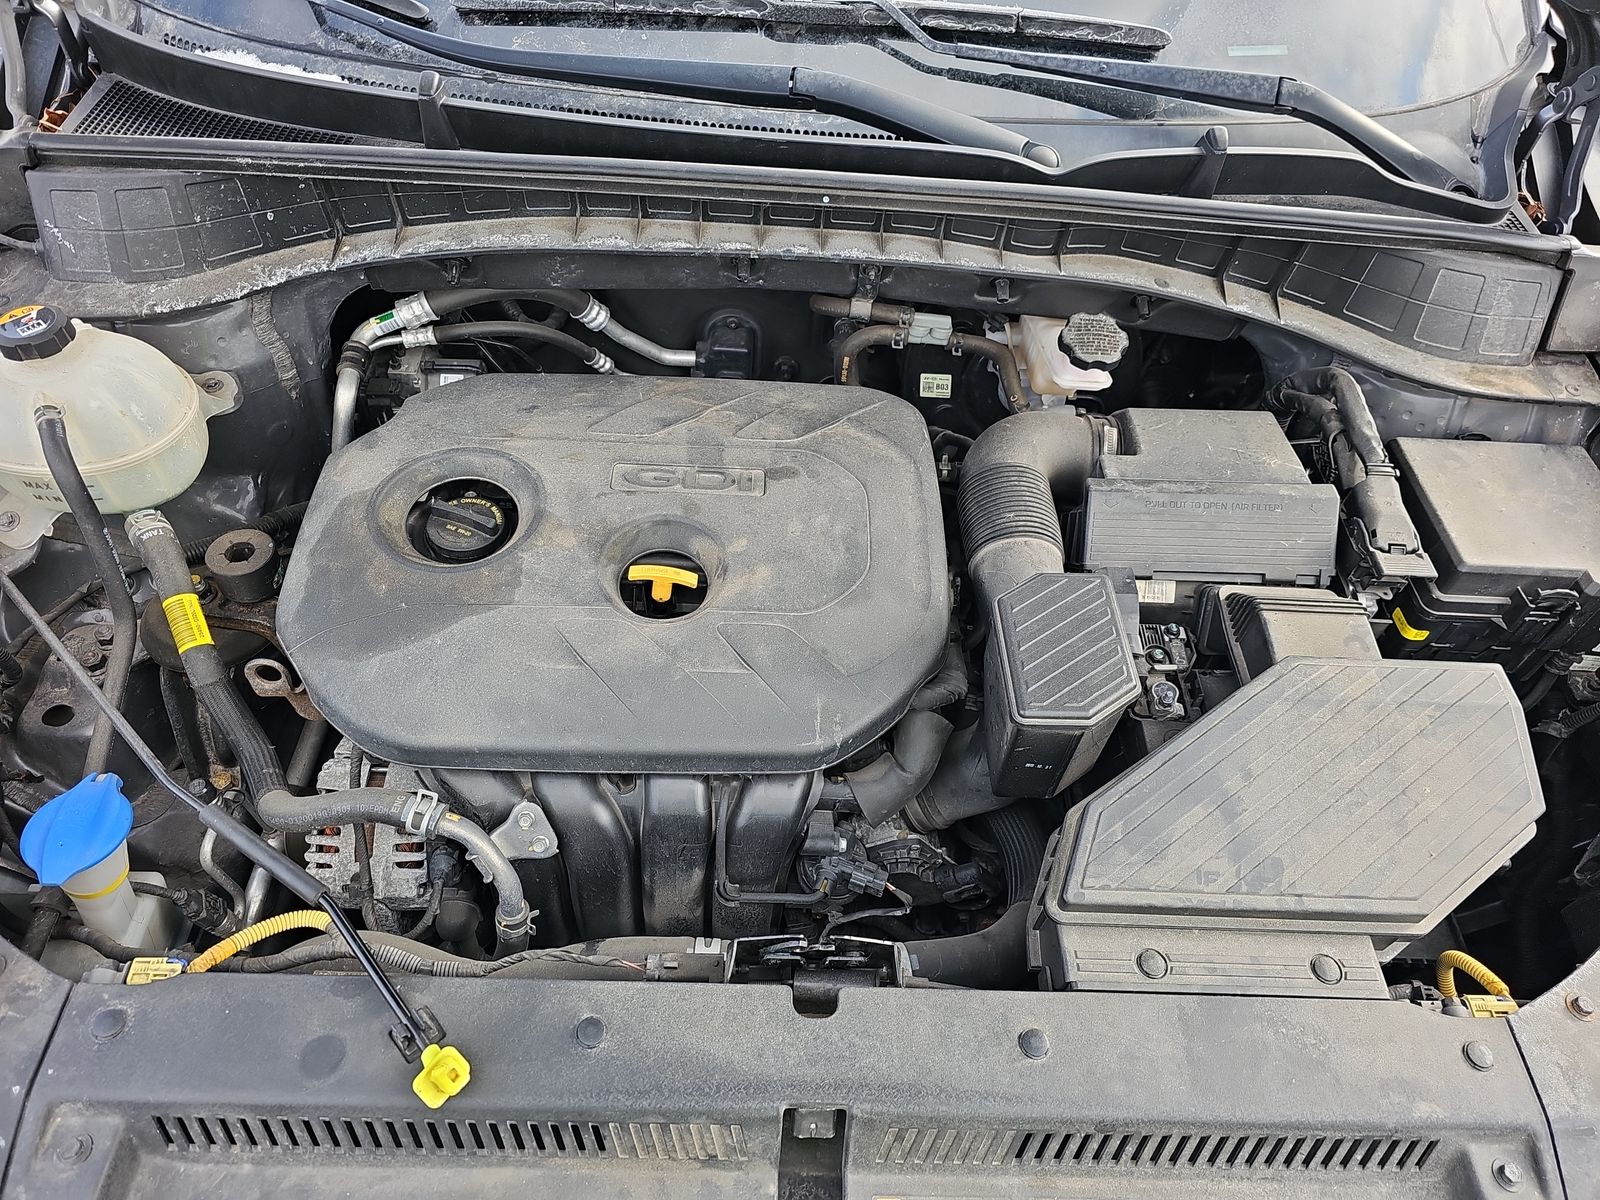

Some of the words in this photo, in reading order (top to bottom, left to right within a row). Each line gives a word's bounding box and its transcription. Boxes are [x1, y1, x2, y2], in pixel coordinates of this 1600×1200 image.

[936, 383, 949, 391] B03
[22, 481, 54, 491] MAX
[33, 494, 63, 503] MIN
[460, 498, 491, 508] OWNER'S
[1144, 500, 1168, 509] PULL
[1169, 500, 1187, 509] OUT
[1191, 501, 1201, 510] TO
[1203, 502, 1228, 511] OPEN
[140, 528, 165, 542] TANK
[391, 795, 406, 814] ENG
